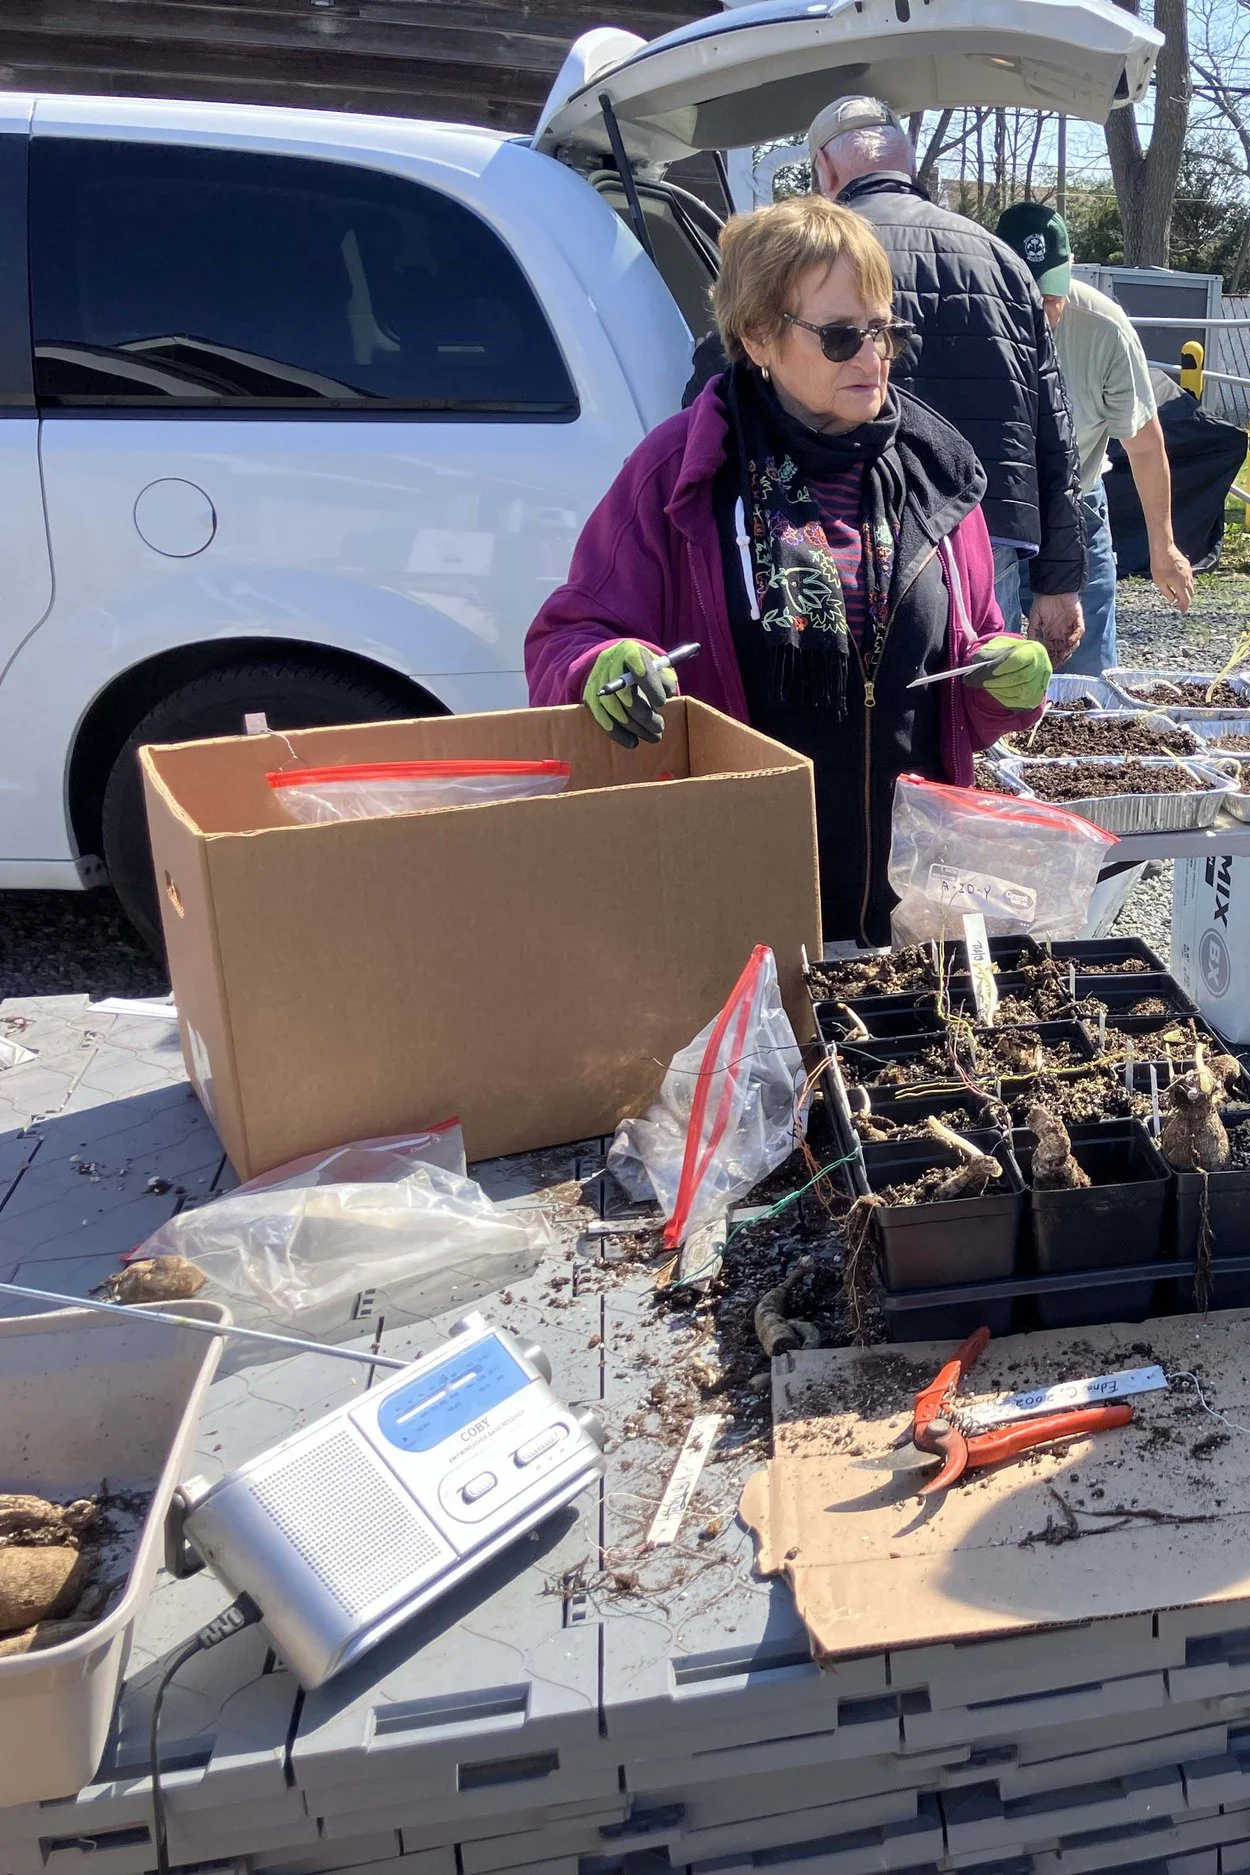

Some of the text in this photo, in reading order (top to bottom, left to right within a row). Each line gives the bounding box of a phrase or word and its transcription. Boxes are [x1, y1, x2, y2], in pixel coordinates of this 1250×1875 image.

[1206, 940, 1221, 985] BX
[1083, 1380, 1119, 1394] Edna
[459, 1417, 491, 1443] COBY
